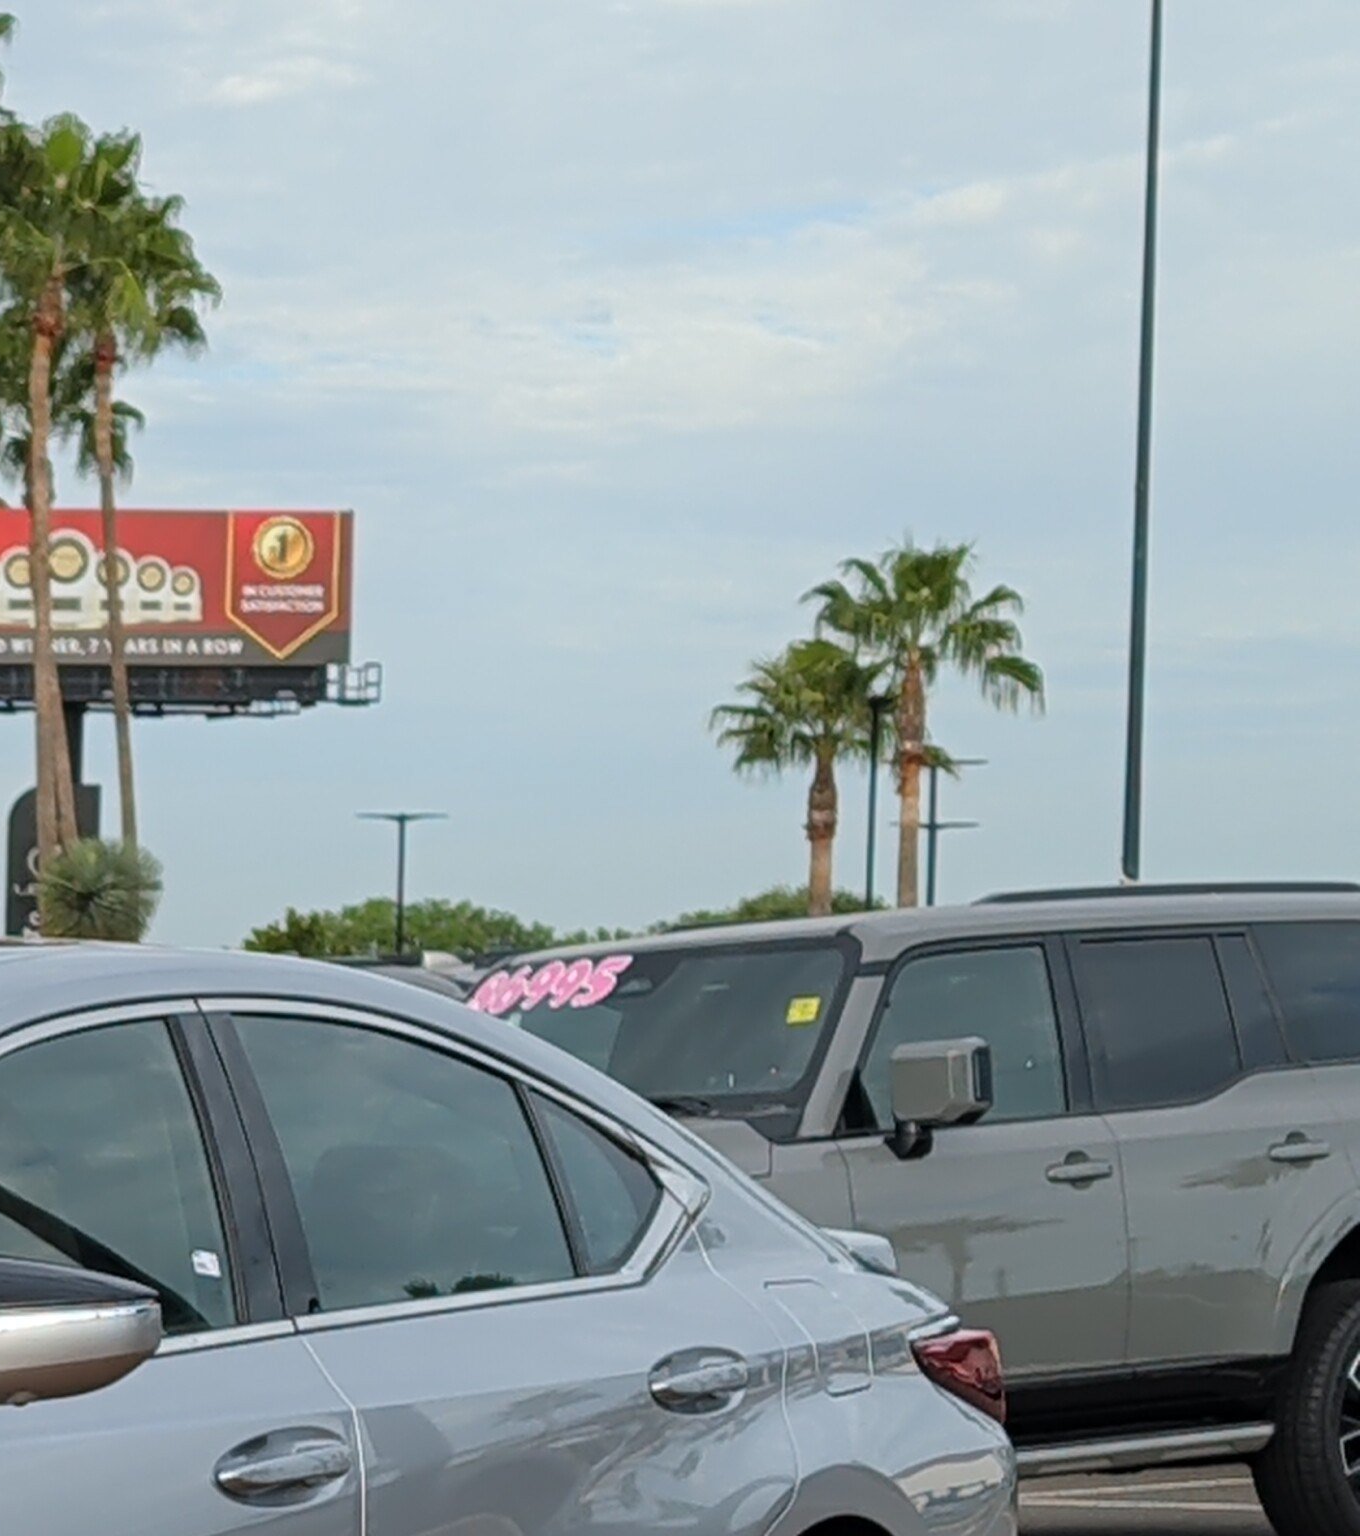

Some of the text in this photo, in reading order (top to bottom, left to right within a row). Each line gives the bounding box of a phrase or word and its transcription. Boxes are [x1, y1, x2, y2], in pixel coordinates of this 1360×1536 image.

[162, 637, 183, 655] IN
[185, 637, 199, 656] A
[201, 637, 245, 656] ROW
